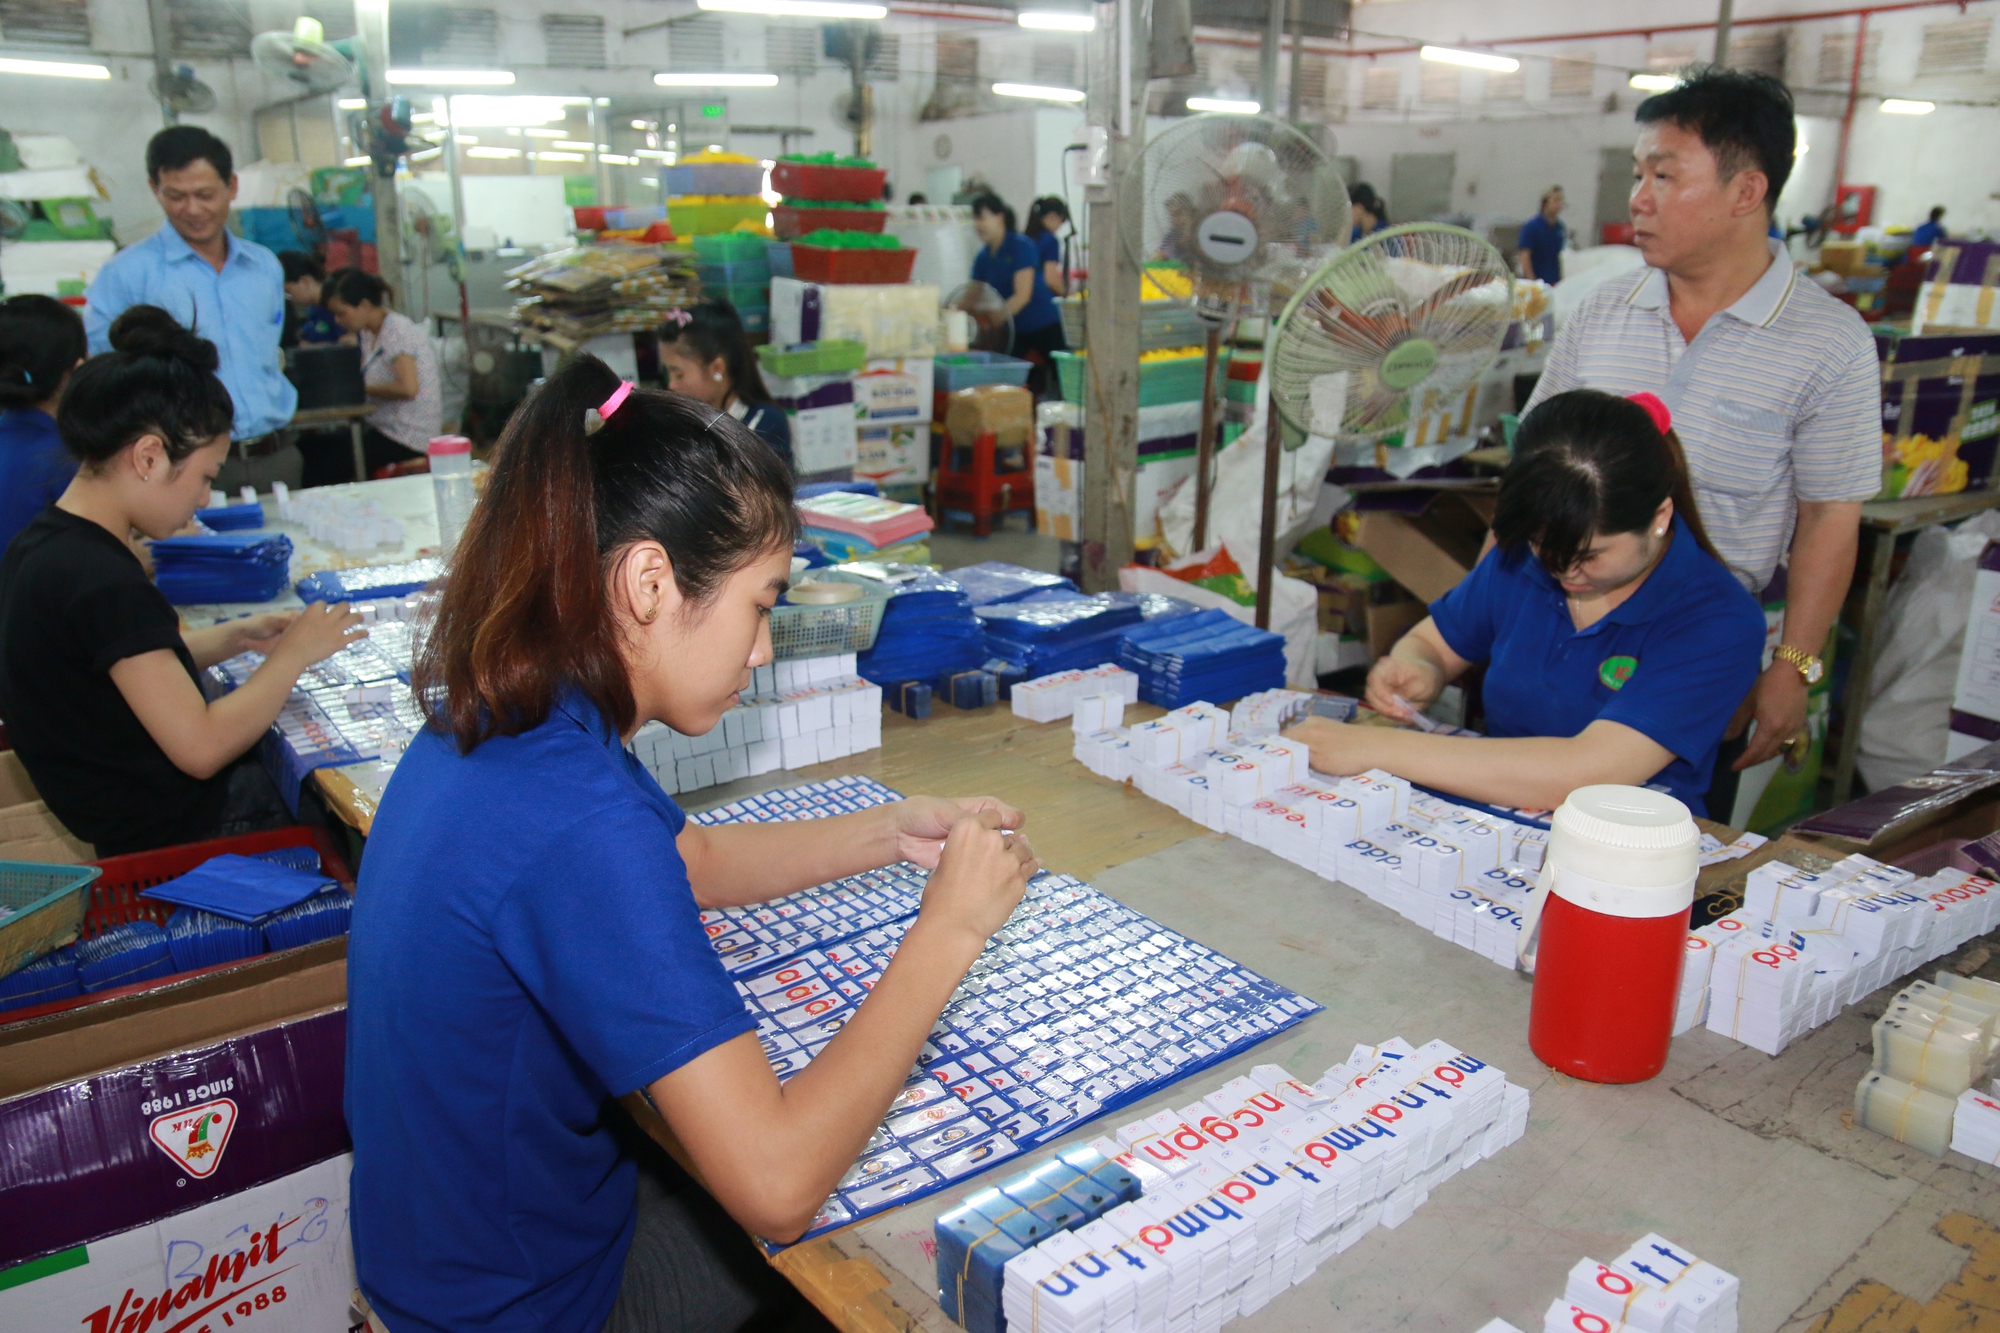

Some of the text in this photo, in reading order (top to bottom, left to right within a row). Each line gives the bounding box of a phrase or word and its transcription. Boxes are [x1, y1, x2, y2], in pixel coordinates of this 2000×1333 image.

[141, 1077, 235, 1116] SINCE 1988
[221, 1285, 288, 1328] 1988
